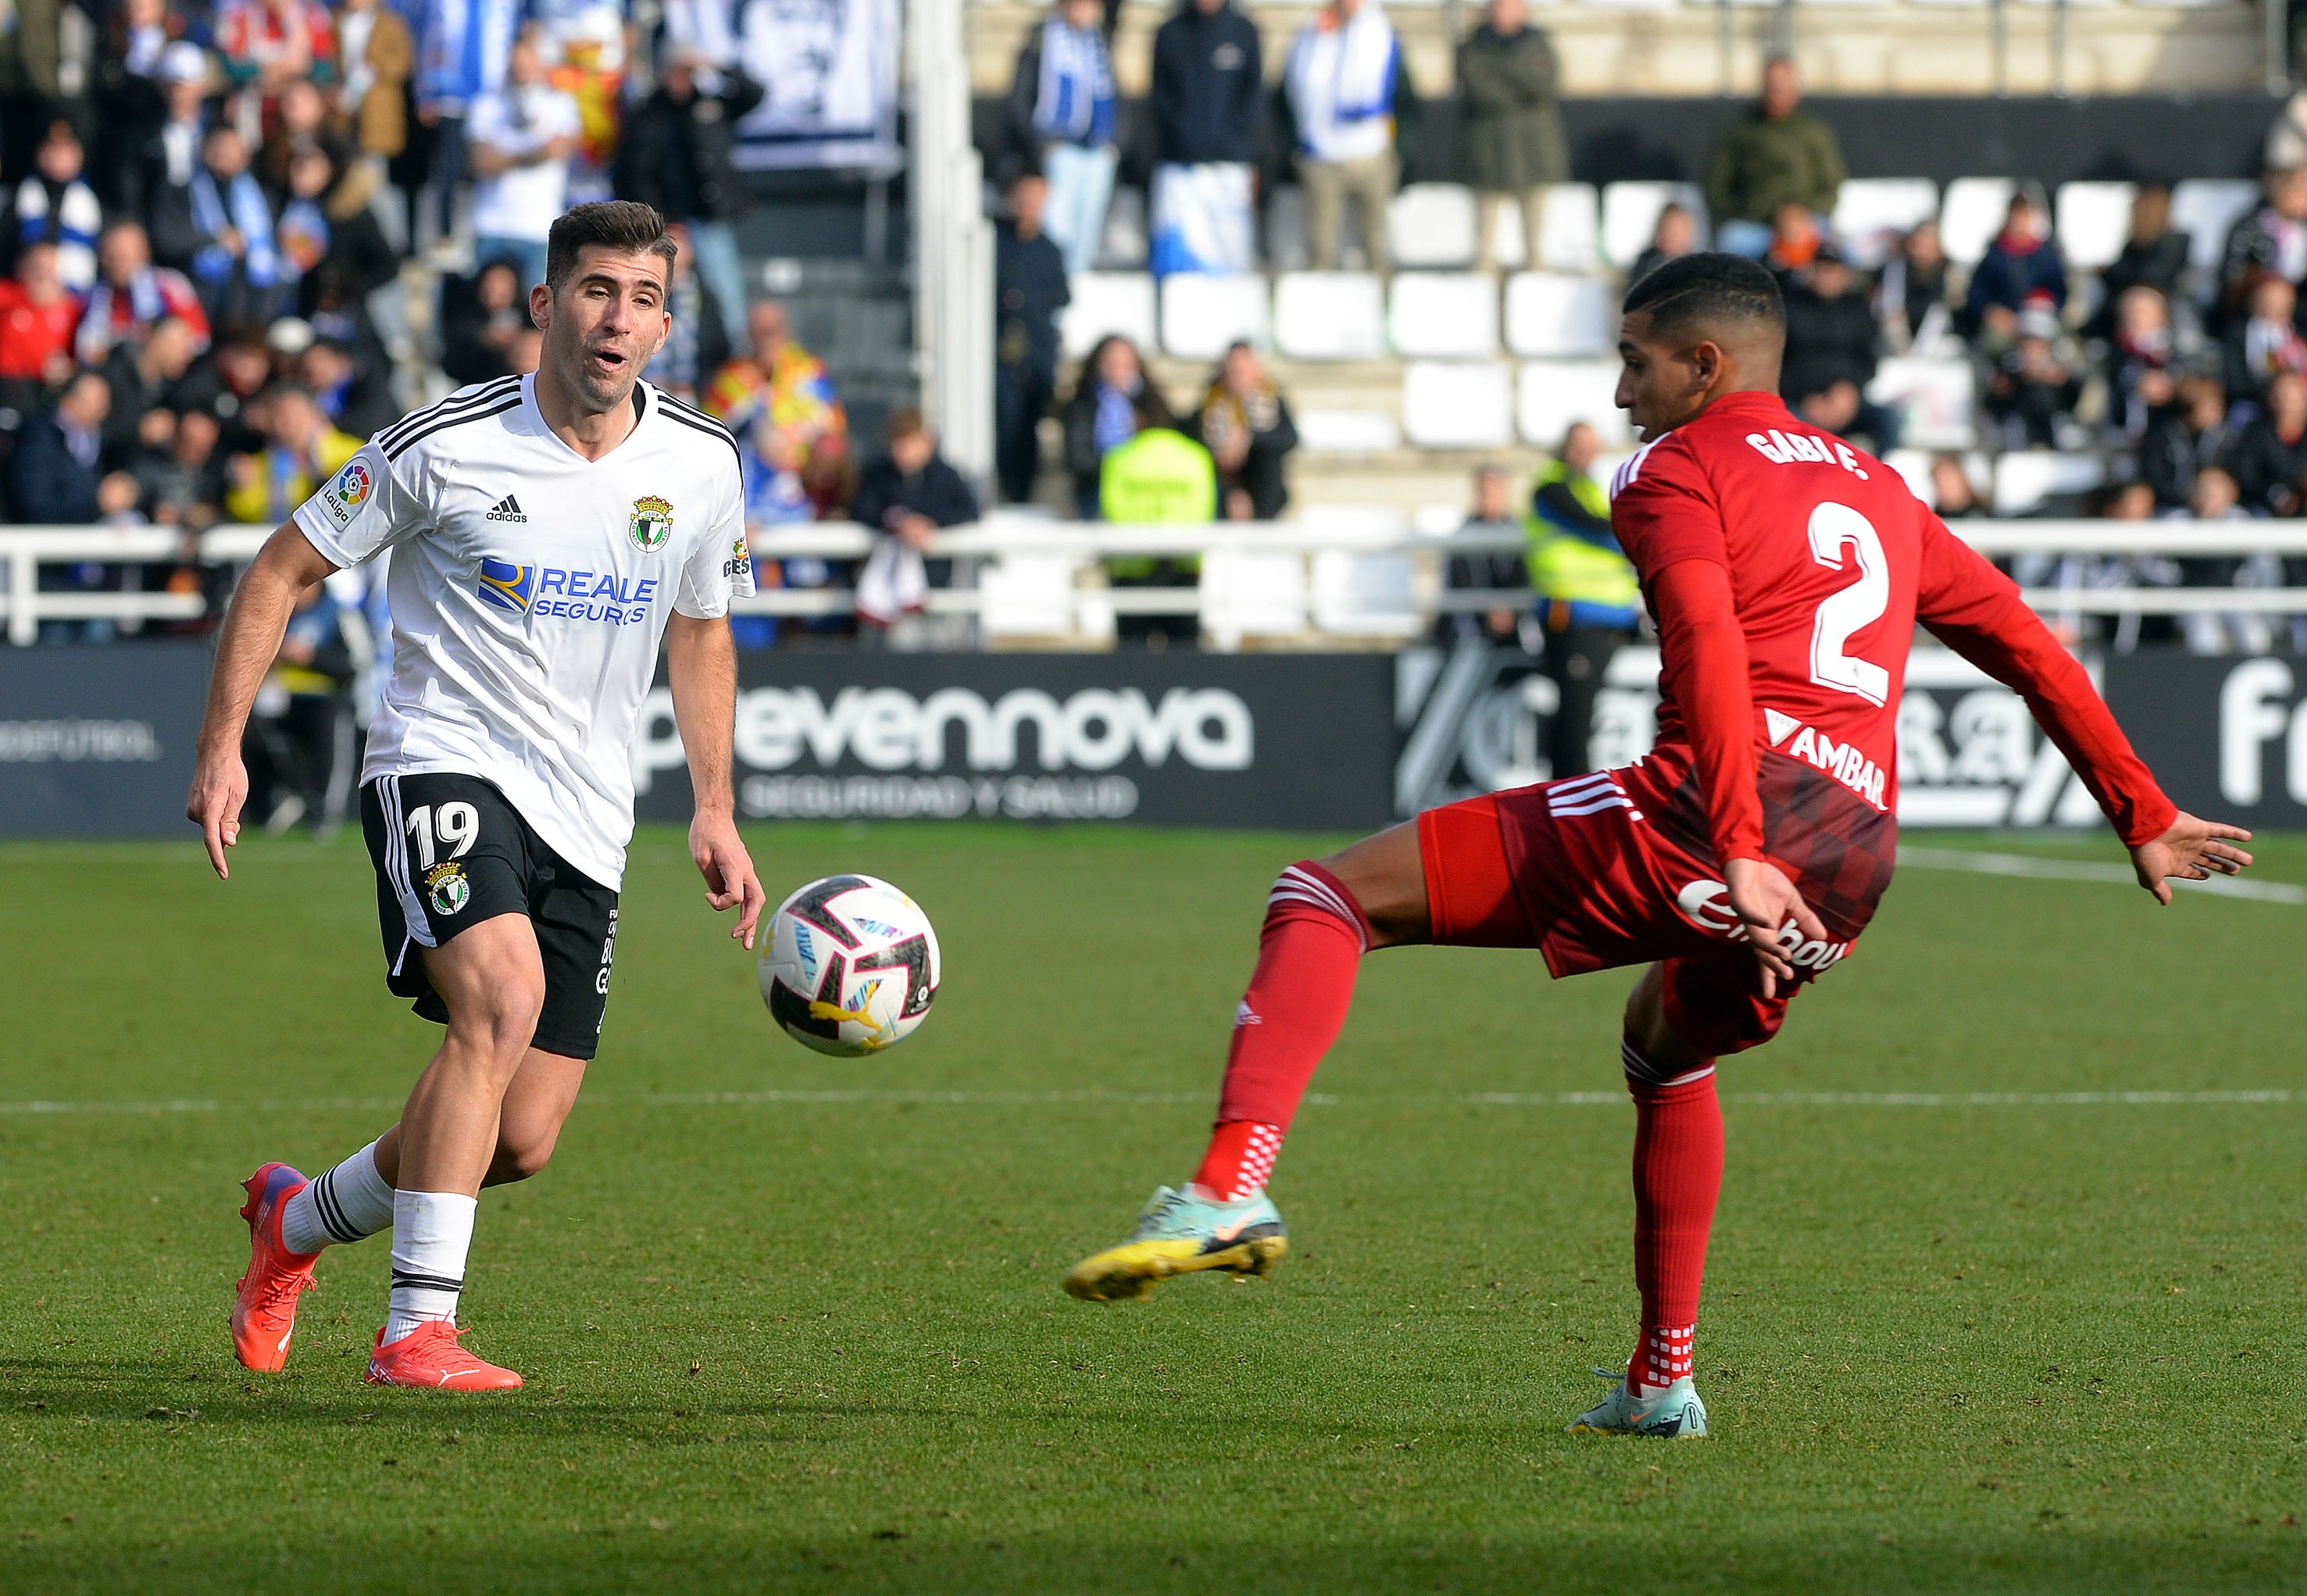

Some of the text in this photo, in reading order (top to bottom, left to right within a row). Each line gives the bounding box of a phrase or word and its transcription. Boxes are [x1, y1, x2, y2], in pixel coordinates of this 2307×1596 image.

[1745, 429, 1870, 481] GABI F.
[323, 488, 350, 524] LaLiga
[486, 511, 528, 523] adidas
[656, 526, 669, 548] FUTBOL
[539, 568, 658, 604] REALE
[1807, 501, 1890, 708] 2
[632, 684, 1255, 795] pevennova
[1788, 726, 1890, 812] AMBAR
[406, 800, 480, 871] 19
[437, 876, 452, 886] CLUB
[460, 881, 469, 903] FUTBOL
[1677, 880, 1848, 970] ebou
